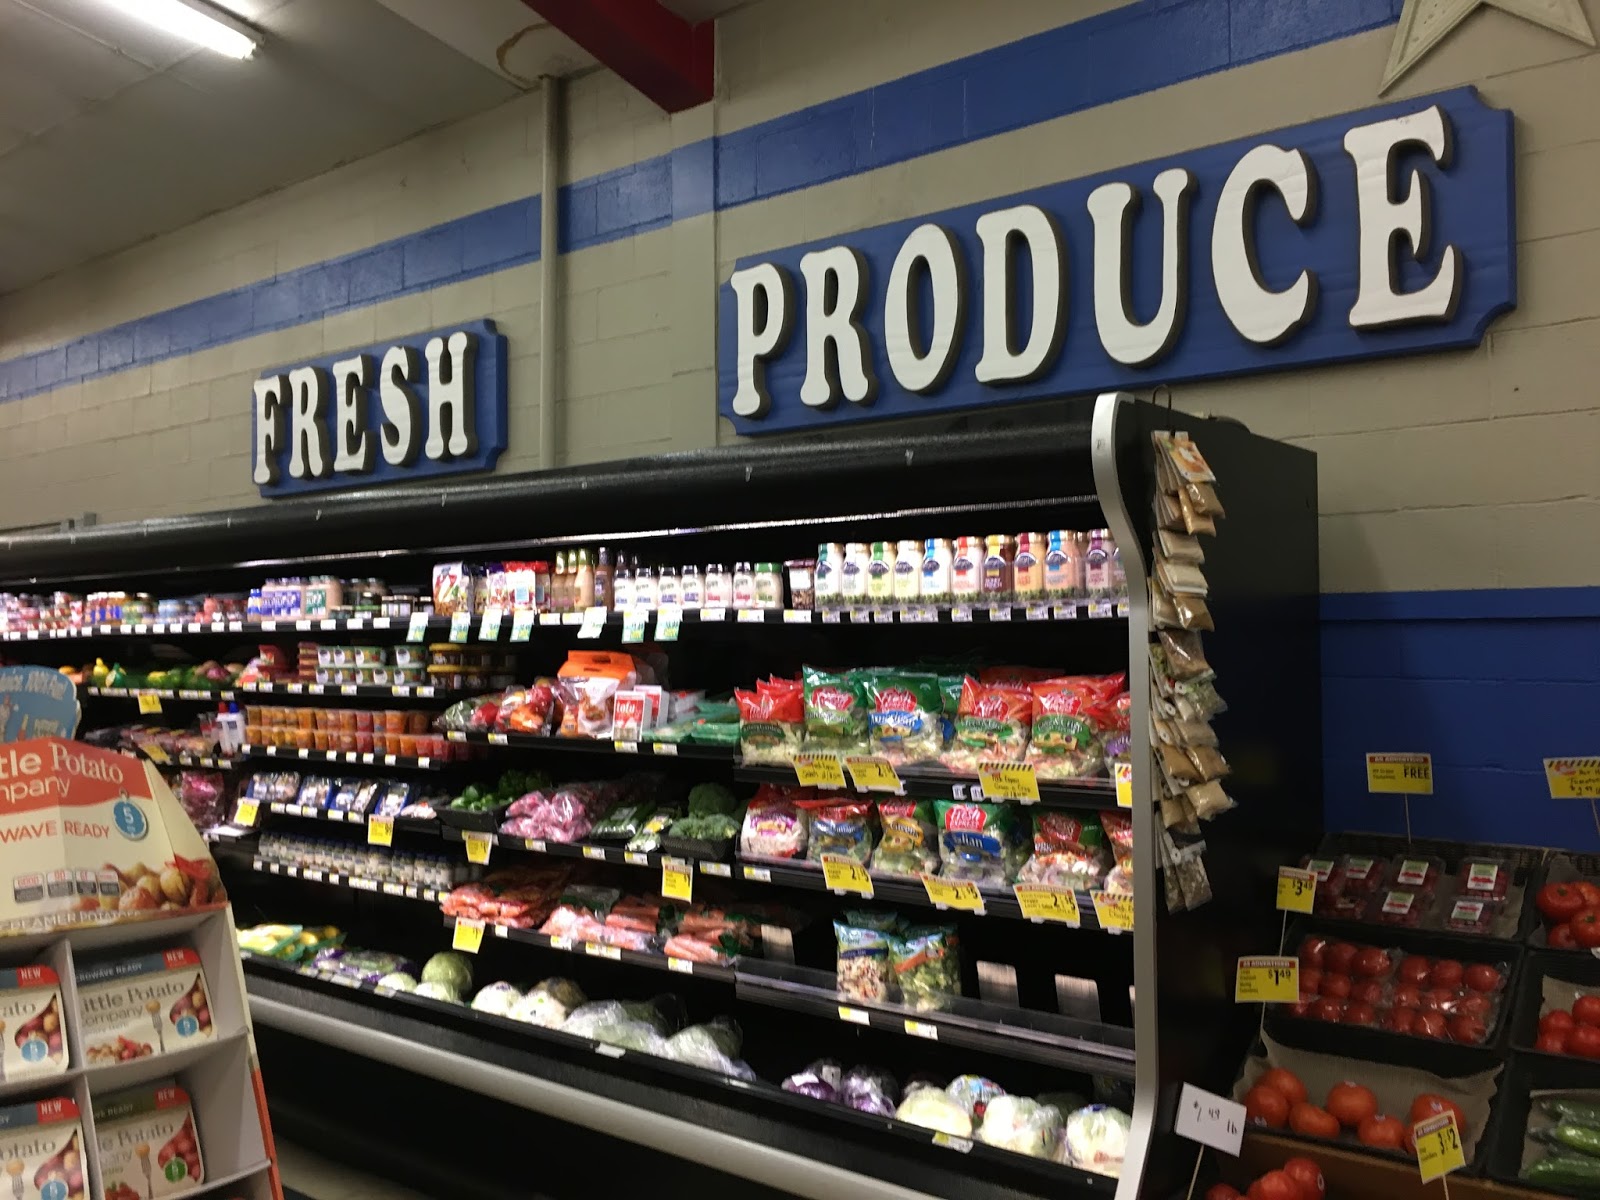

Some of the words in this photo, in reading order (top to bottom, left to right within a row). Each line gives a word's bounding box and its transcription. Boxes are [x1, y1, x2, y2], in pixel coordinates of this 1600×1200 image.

[731, 104, 1456, 418] PRODUCE
[254, 331, 469, 485] FRESH
[48, 741, 124, 784] Potato
[1404, 767, 1431, 780] FREE
[123, 806, 134, 825] 5
[0, 821, 57, 843] WAVE
[64, 820, 110, 838] READY
[166, 950, 185, 962] NEW
[21, 967, 41, 980] NEW
[116, 963, 142, 975] READY
[127, 982, 185, 1004] Potato
[158, 1089, 175, 1102] NEW
[41, 1099, 62, 1115] NEW
